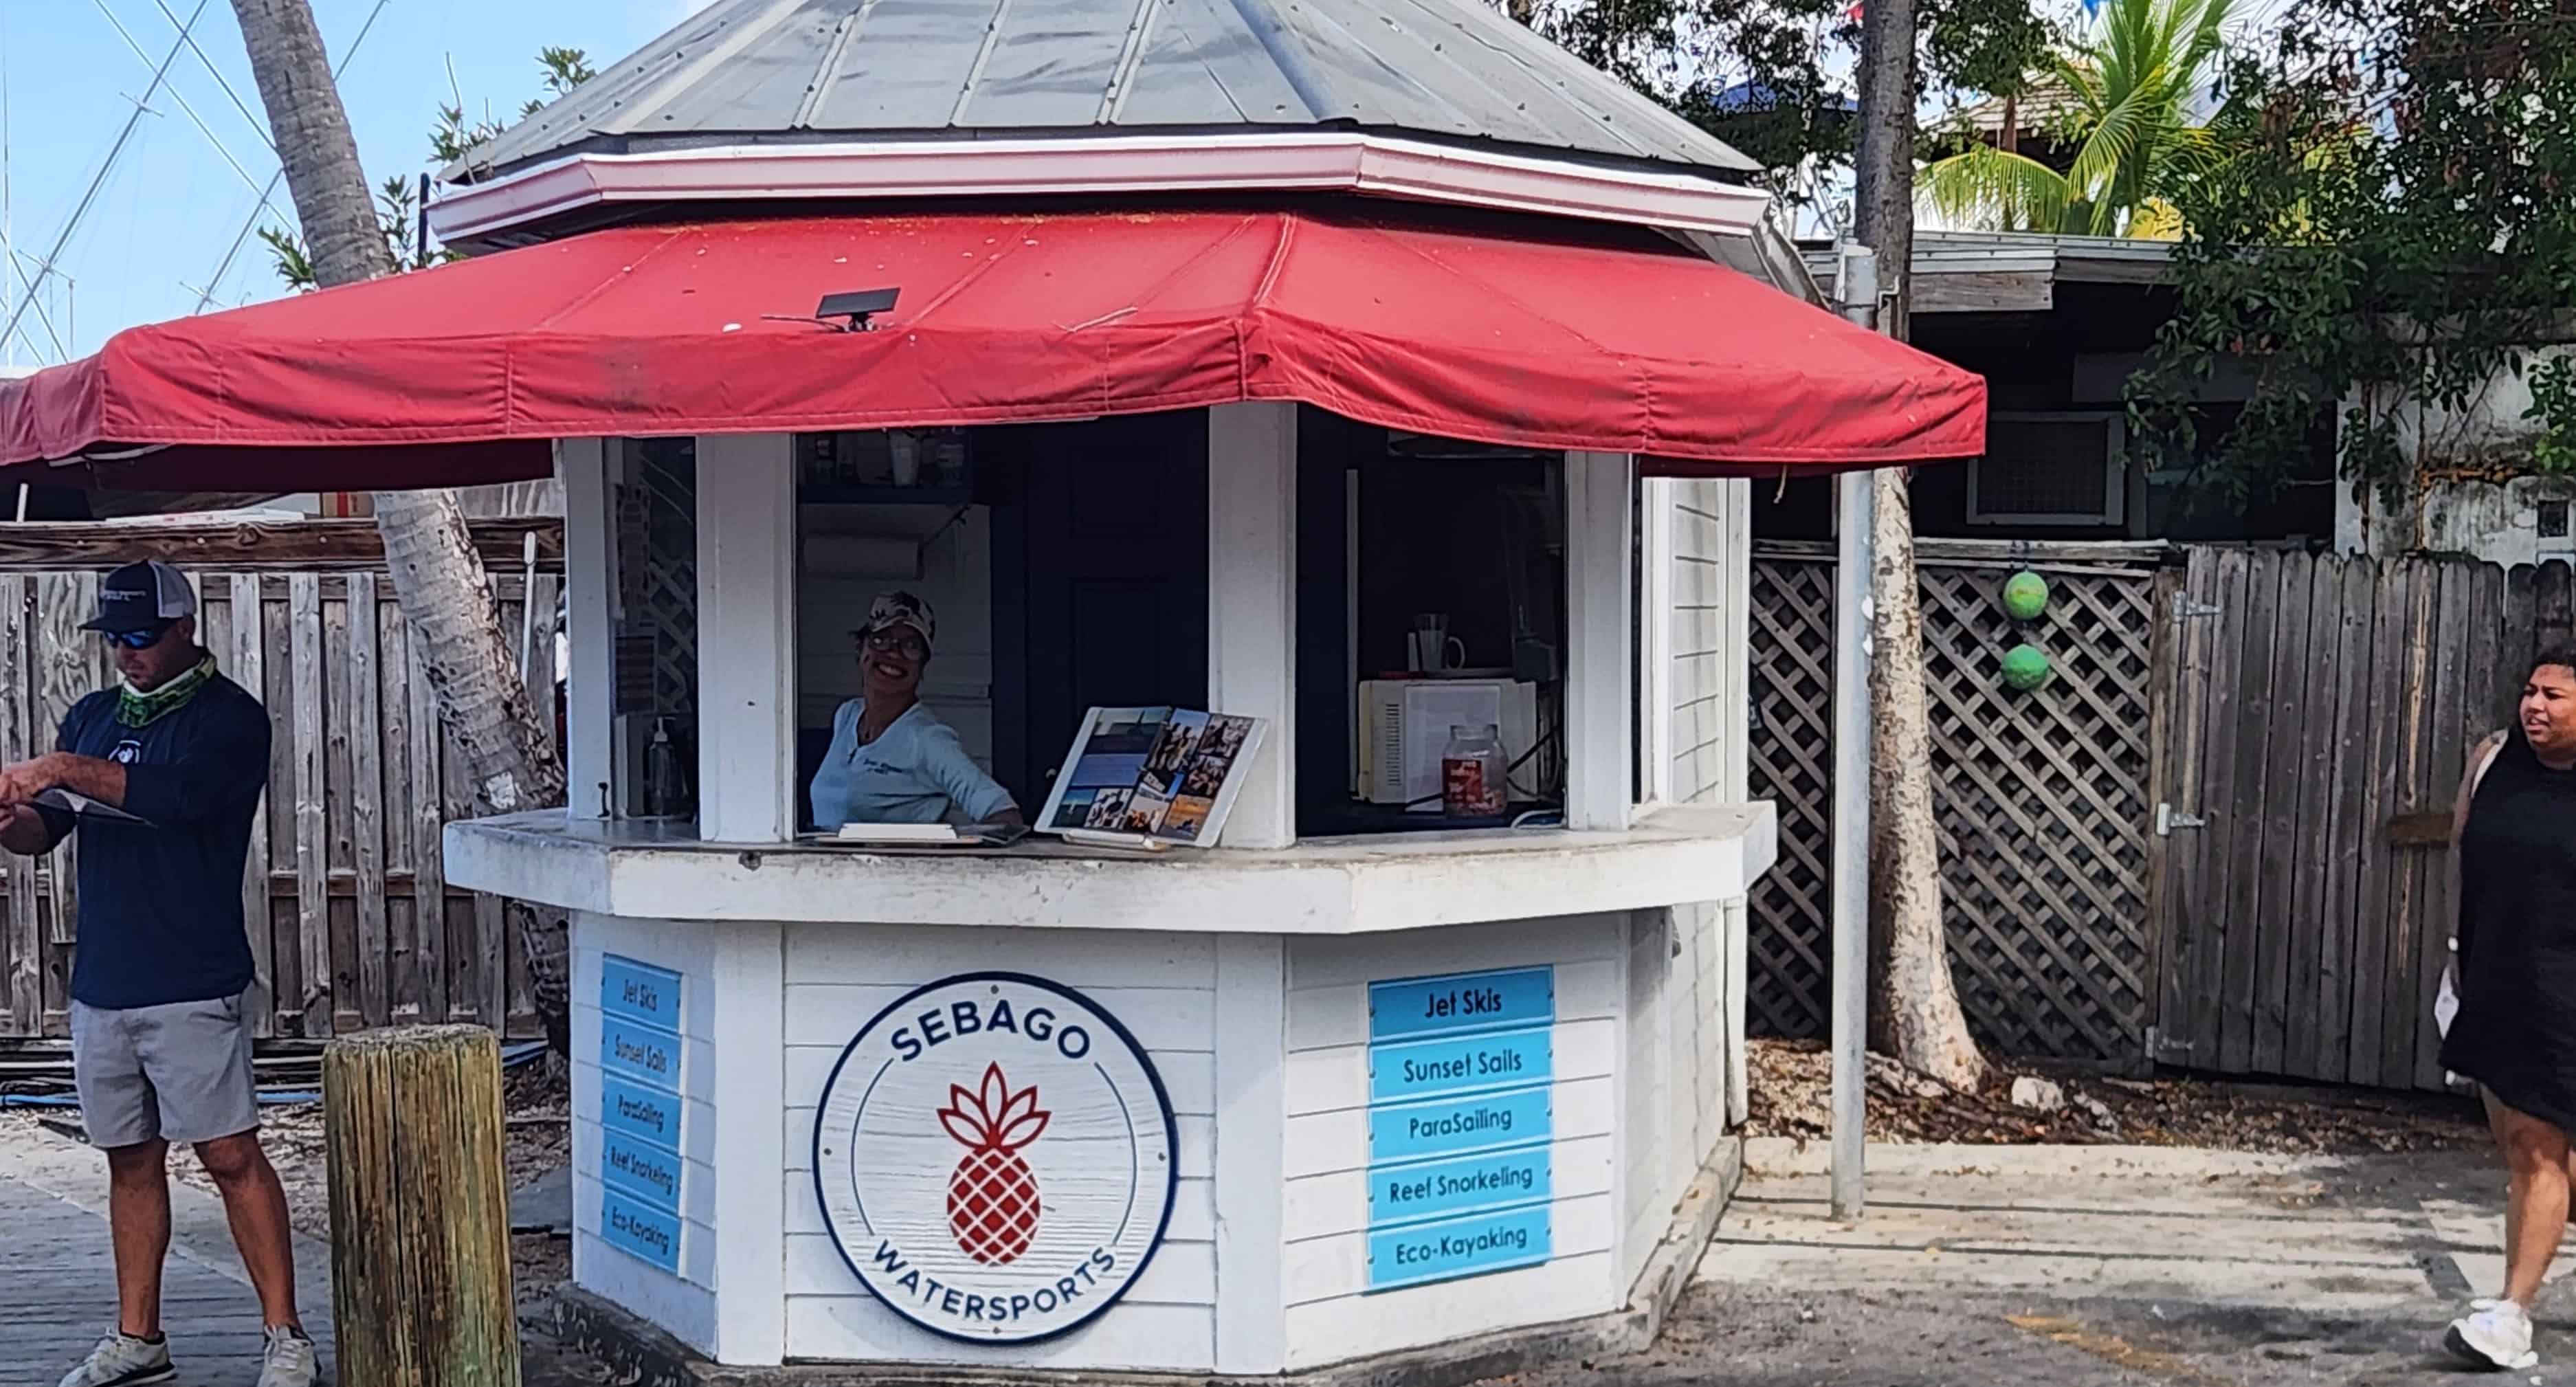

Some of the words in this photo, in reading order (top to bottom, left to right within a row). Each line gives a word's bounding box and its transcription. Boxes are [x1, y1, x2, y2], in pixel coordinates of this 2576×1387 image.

[623, 979, 639, 1004] Jet
[639, 984, 658, 1012] Skis
[1425, 993, 1456, 1018] Jet
[1463, 987, 1502, 1014] Skis
[891, 999, 1091, 1061] SEBAGO
[614, 1033, 645, 1065] Sunset
[646, 1044, 667, 1074] Sails
[1403, 1053, 1472, 1083] Sunset
[1478, 1049, 1522, 1075] Sails
[1409, 1108, 1513, 1140] ParaSailing
[1390, 1176, 1432, 1203] Reef
[1437, 1166, 1533, 1197] Snorkeling
[1396, 1225, 1527, 1265] Eco-Kayaking
[874, 1239, 1115, 1321] WATERSPORTS
